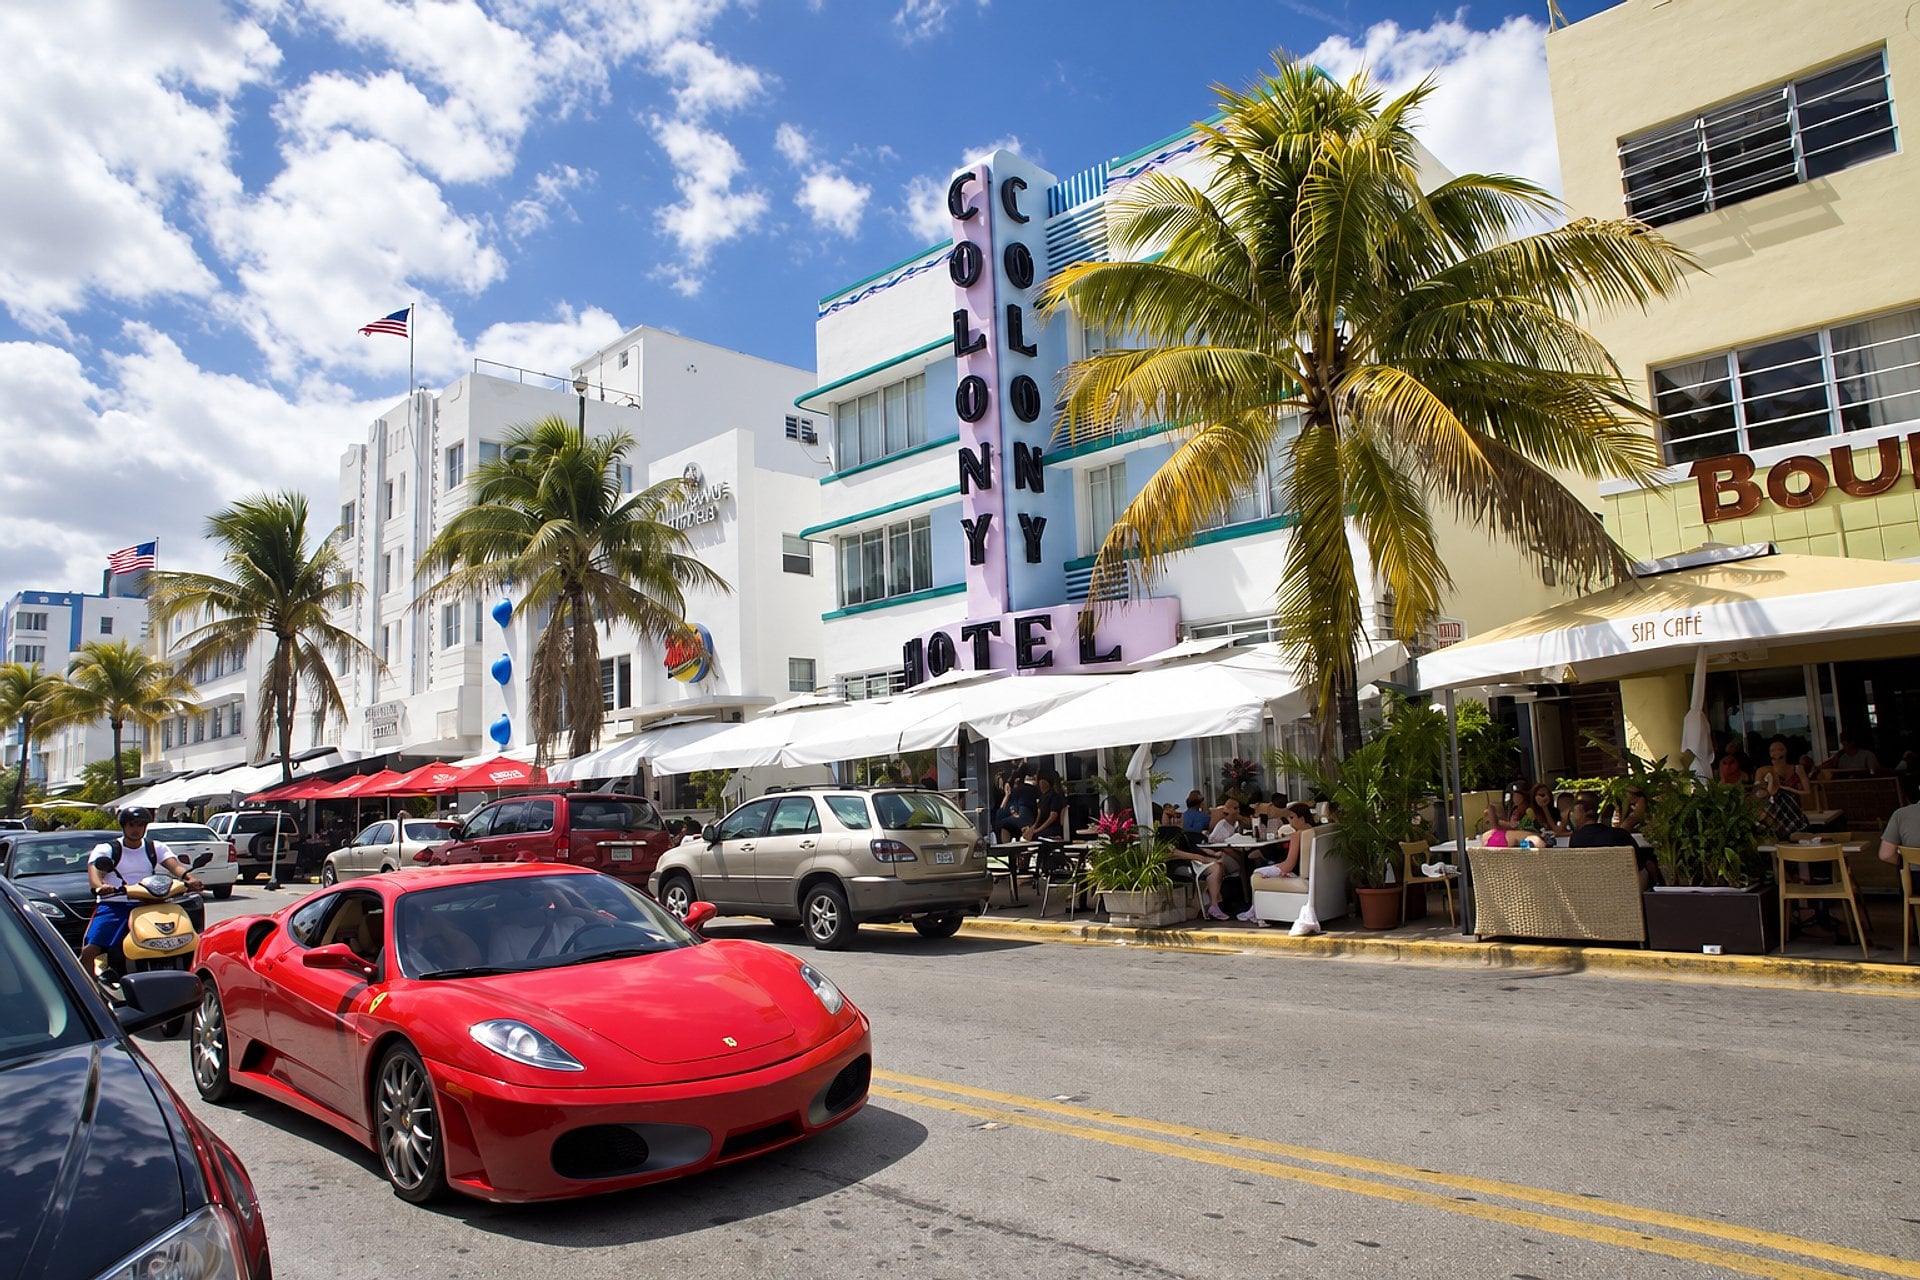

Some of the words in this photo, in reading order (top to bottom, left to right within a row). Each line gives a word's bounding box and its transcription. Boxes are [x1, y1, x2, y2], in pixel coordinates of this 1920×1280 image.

[948, 172, 993, 565] COLONY
[1001, 176, 1048, 564] COLONY
[1688, 433, 1920, 524] BOU
[903, 611, 1122, 690] HOTEL
[1632, 621, 1655, 643] SIR
[1663, 611, 1703, 637] CAFÉ
